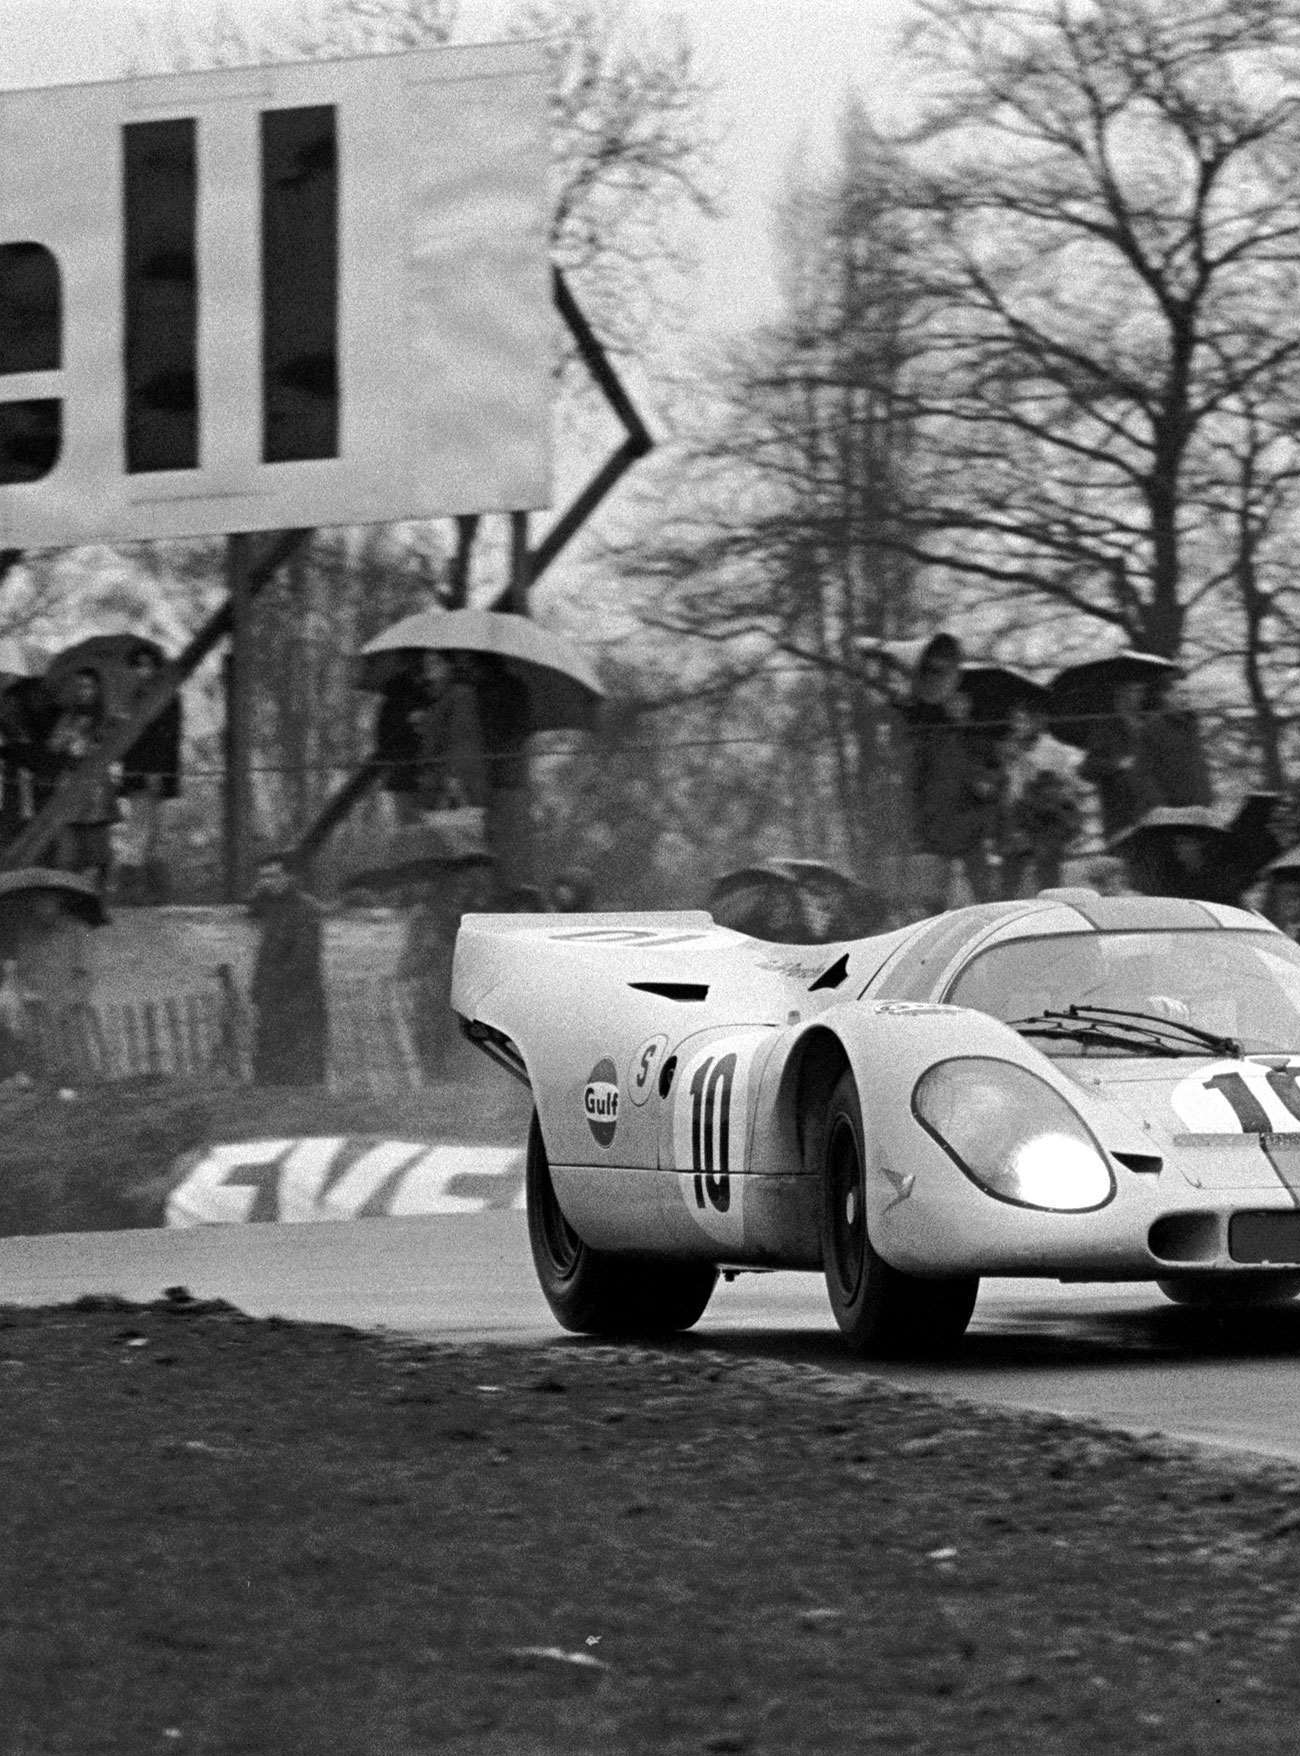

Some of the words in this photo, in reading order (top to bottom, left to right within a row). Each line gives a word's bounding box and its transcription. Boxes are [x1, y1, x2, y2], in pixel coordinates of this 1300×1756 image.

[637, 1044, 657, 1087] S
[585, 1087, 619, 1116] Gulf
[690, 1053, 738, 1213] 10
